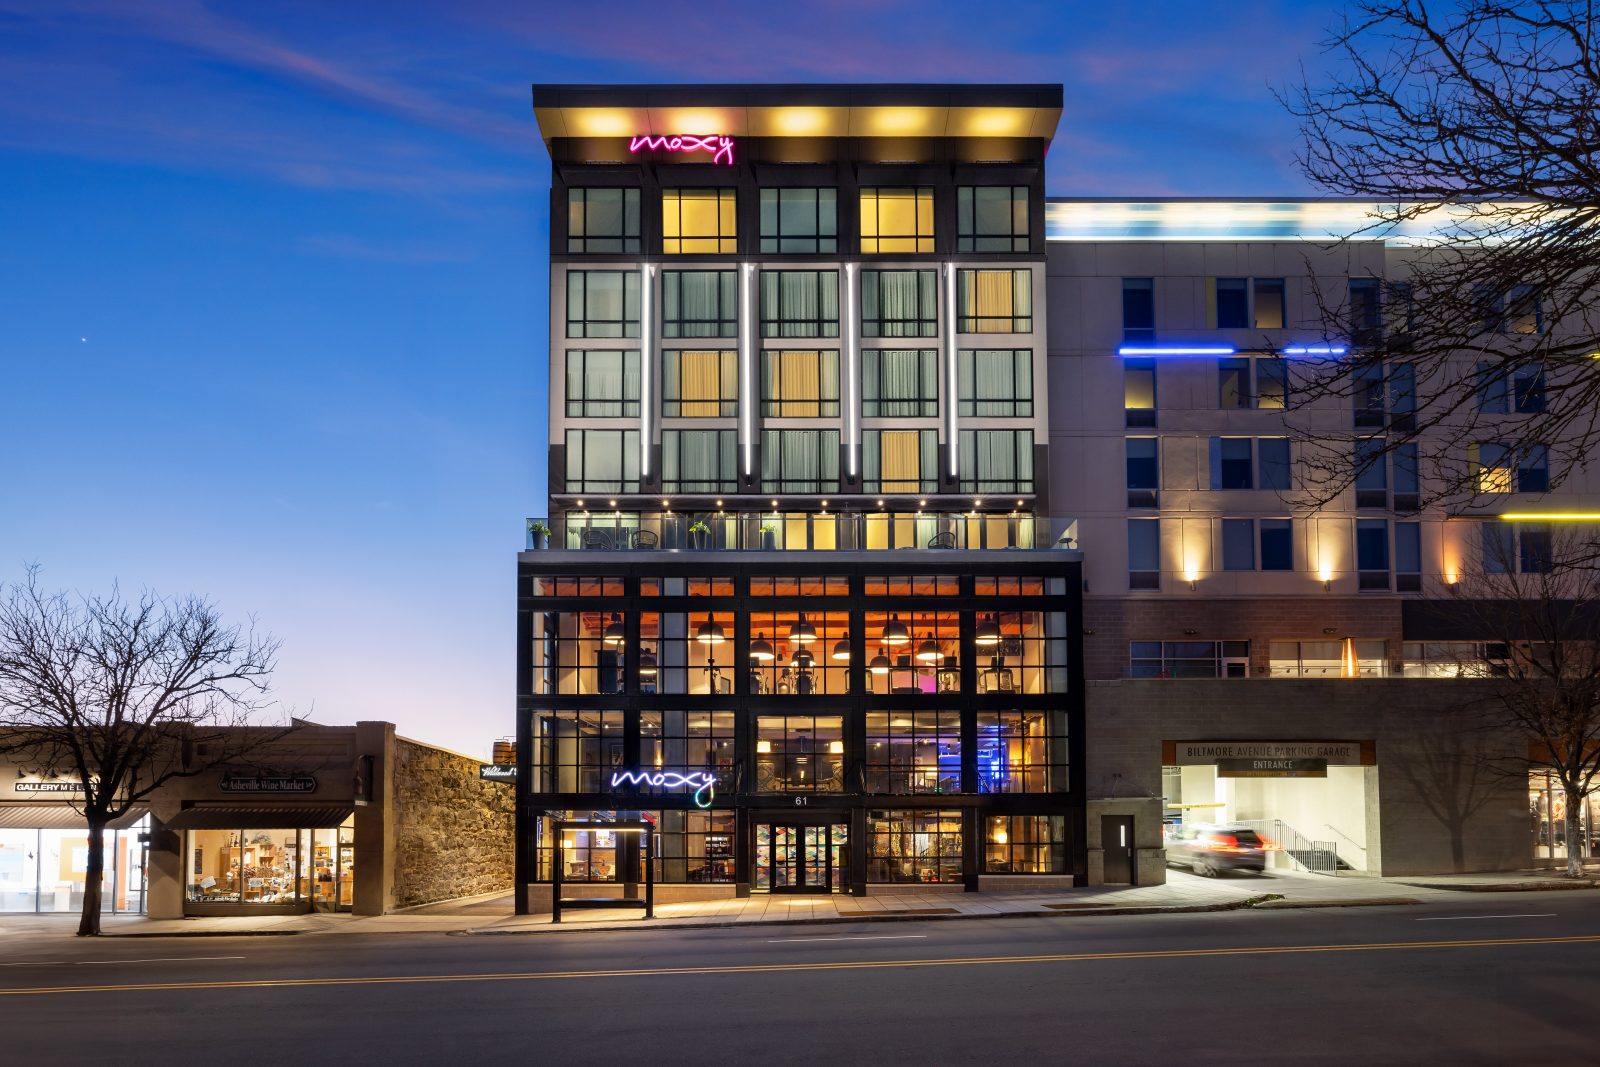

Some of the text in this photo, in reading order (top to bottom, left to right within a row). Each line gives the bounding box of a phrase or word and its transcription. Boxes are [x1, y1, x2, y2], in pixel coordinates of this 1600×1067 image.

[630, 136, 734, 165] moxy
[1187, 747, 1351, 757] BILTMORE AVENUE PARKING GARAGE
[1253, 760, 1293, 769] ENTRANCE
[230, 780, 305, 790] Asheville Wine Market
[611, 772, 717, 808] moxy
[795, 796, 807, 806] 61
